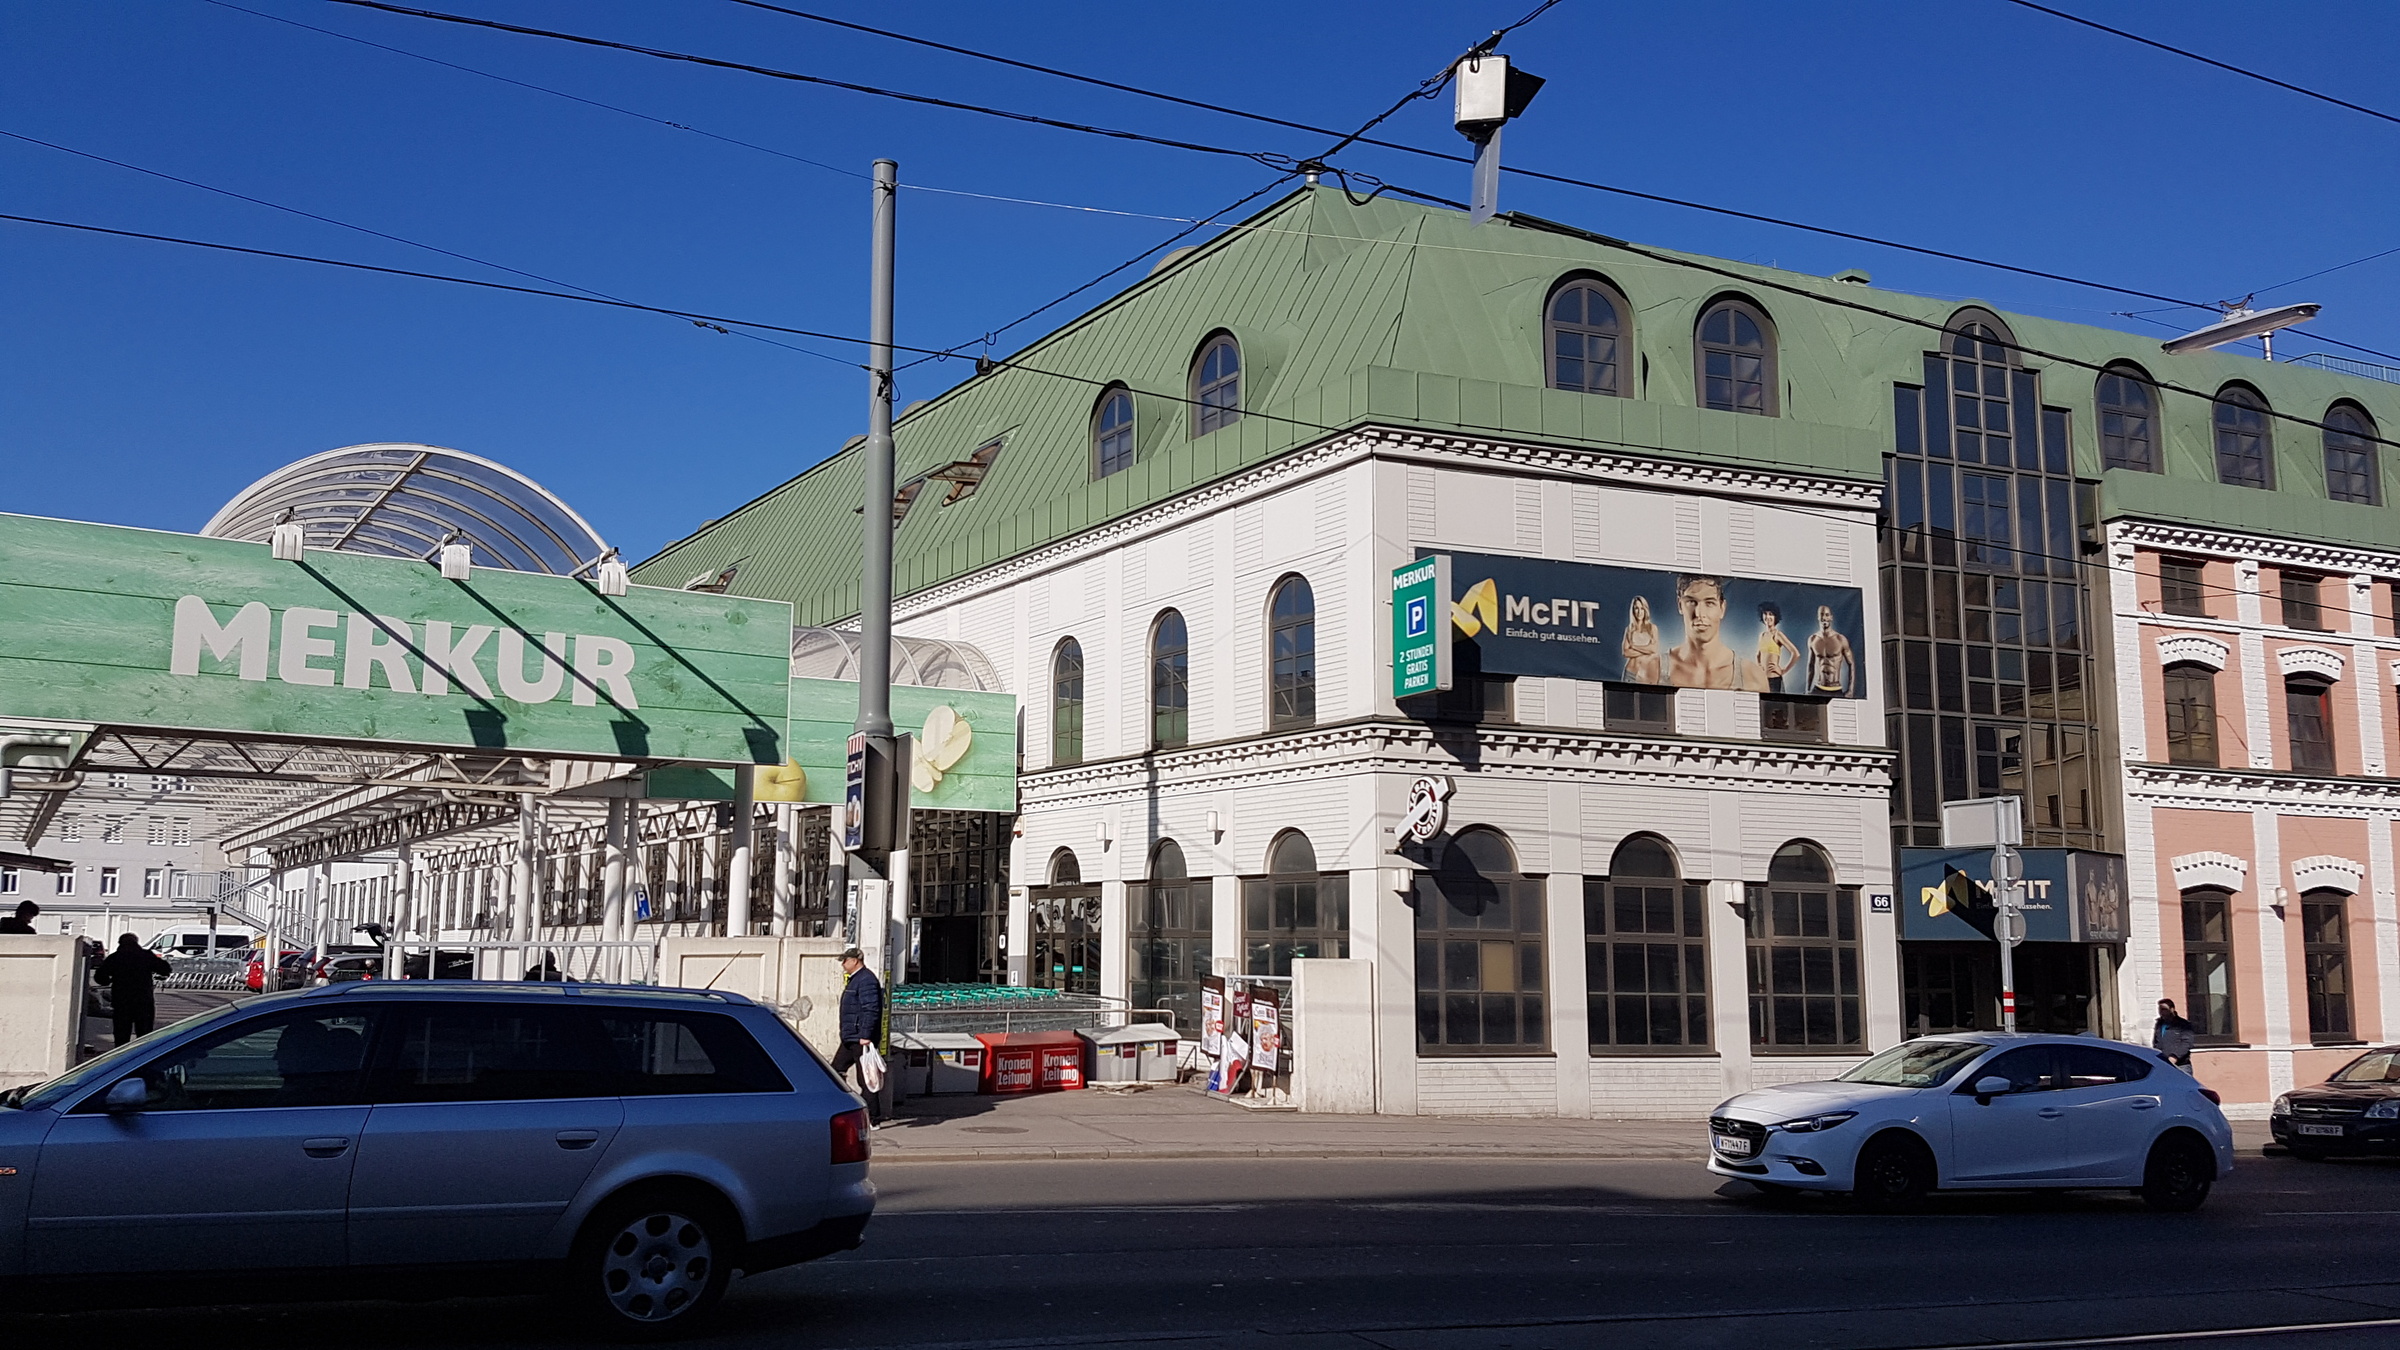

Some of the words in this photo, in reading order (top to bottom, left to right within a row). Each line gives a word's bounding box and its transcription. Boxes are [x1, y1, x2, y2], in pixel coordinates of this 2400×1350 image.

[1393, 564, 1435, 591] MERKUR
[1412, 605, 1423, 630] P
[1505, 594, 1600, 628] McFIT
[1505, 627, 1538, 639] Einfach
[1540, 632, 1555, 642] gut
[1557, 633, 1601, 644] aussehen.
[170, 595, 639, 709] MERKUR
[1399, 651, 1405, 663] 2
[1406, 643, 1434, 661] STUNDEN
[1406, 659, 1428, 675] GRATIS
[1404, 672, 1429, 689] PARKEN
[1975, 880, 2051, 899] MIT
[1874, 896, 1889, 907] 66
[998, 1057, 1031, 1071] Kronen
[1043, 1053, 1077, 1067] Kronen
[998, 1071, 1031, 1085] Zeitung
[1043, 1067, 1078, 1081] Zeitung
